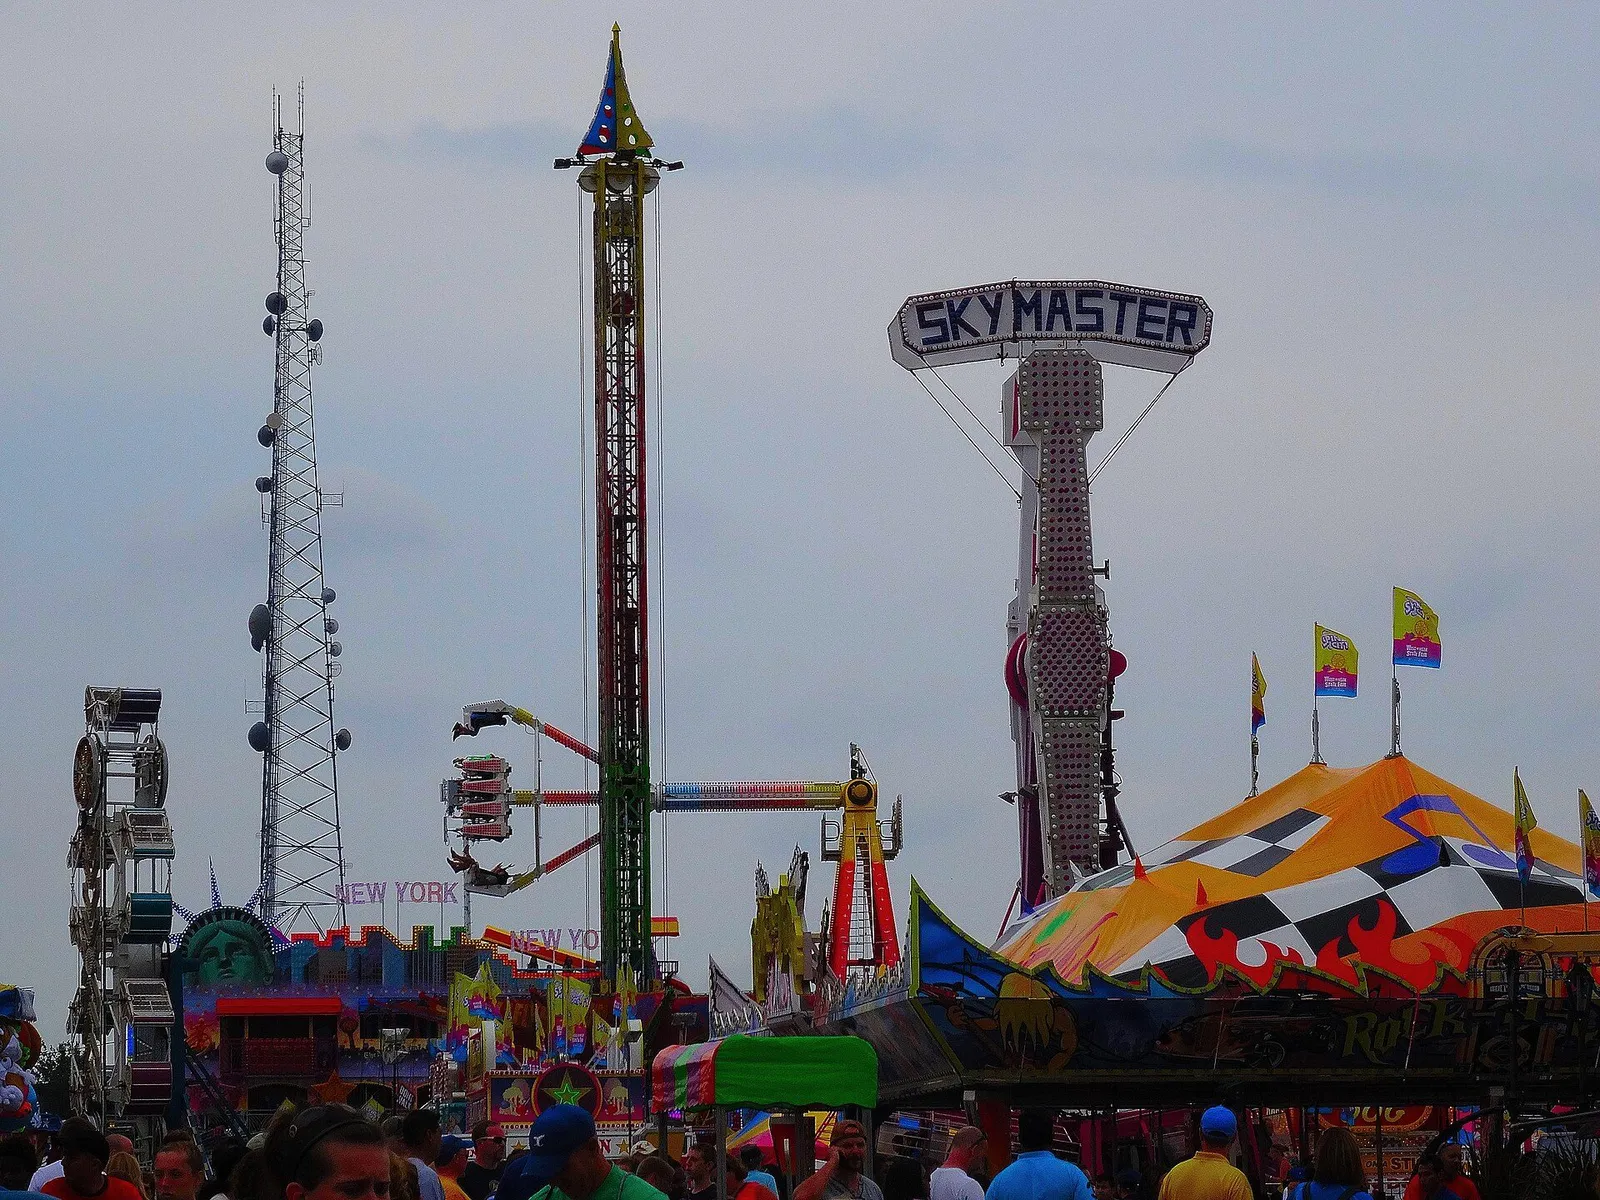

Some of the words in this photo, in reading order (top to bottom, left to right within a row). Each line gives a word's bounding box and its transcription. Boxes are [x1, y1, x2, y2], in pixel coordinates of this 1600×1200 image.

[915, 289, 1198, 346] SKYMASTER
[335, 882, 386, 905] NEW
[395, 881, 458, 904] YORK
[510, 928, 562, 952] NEW
